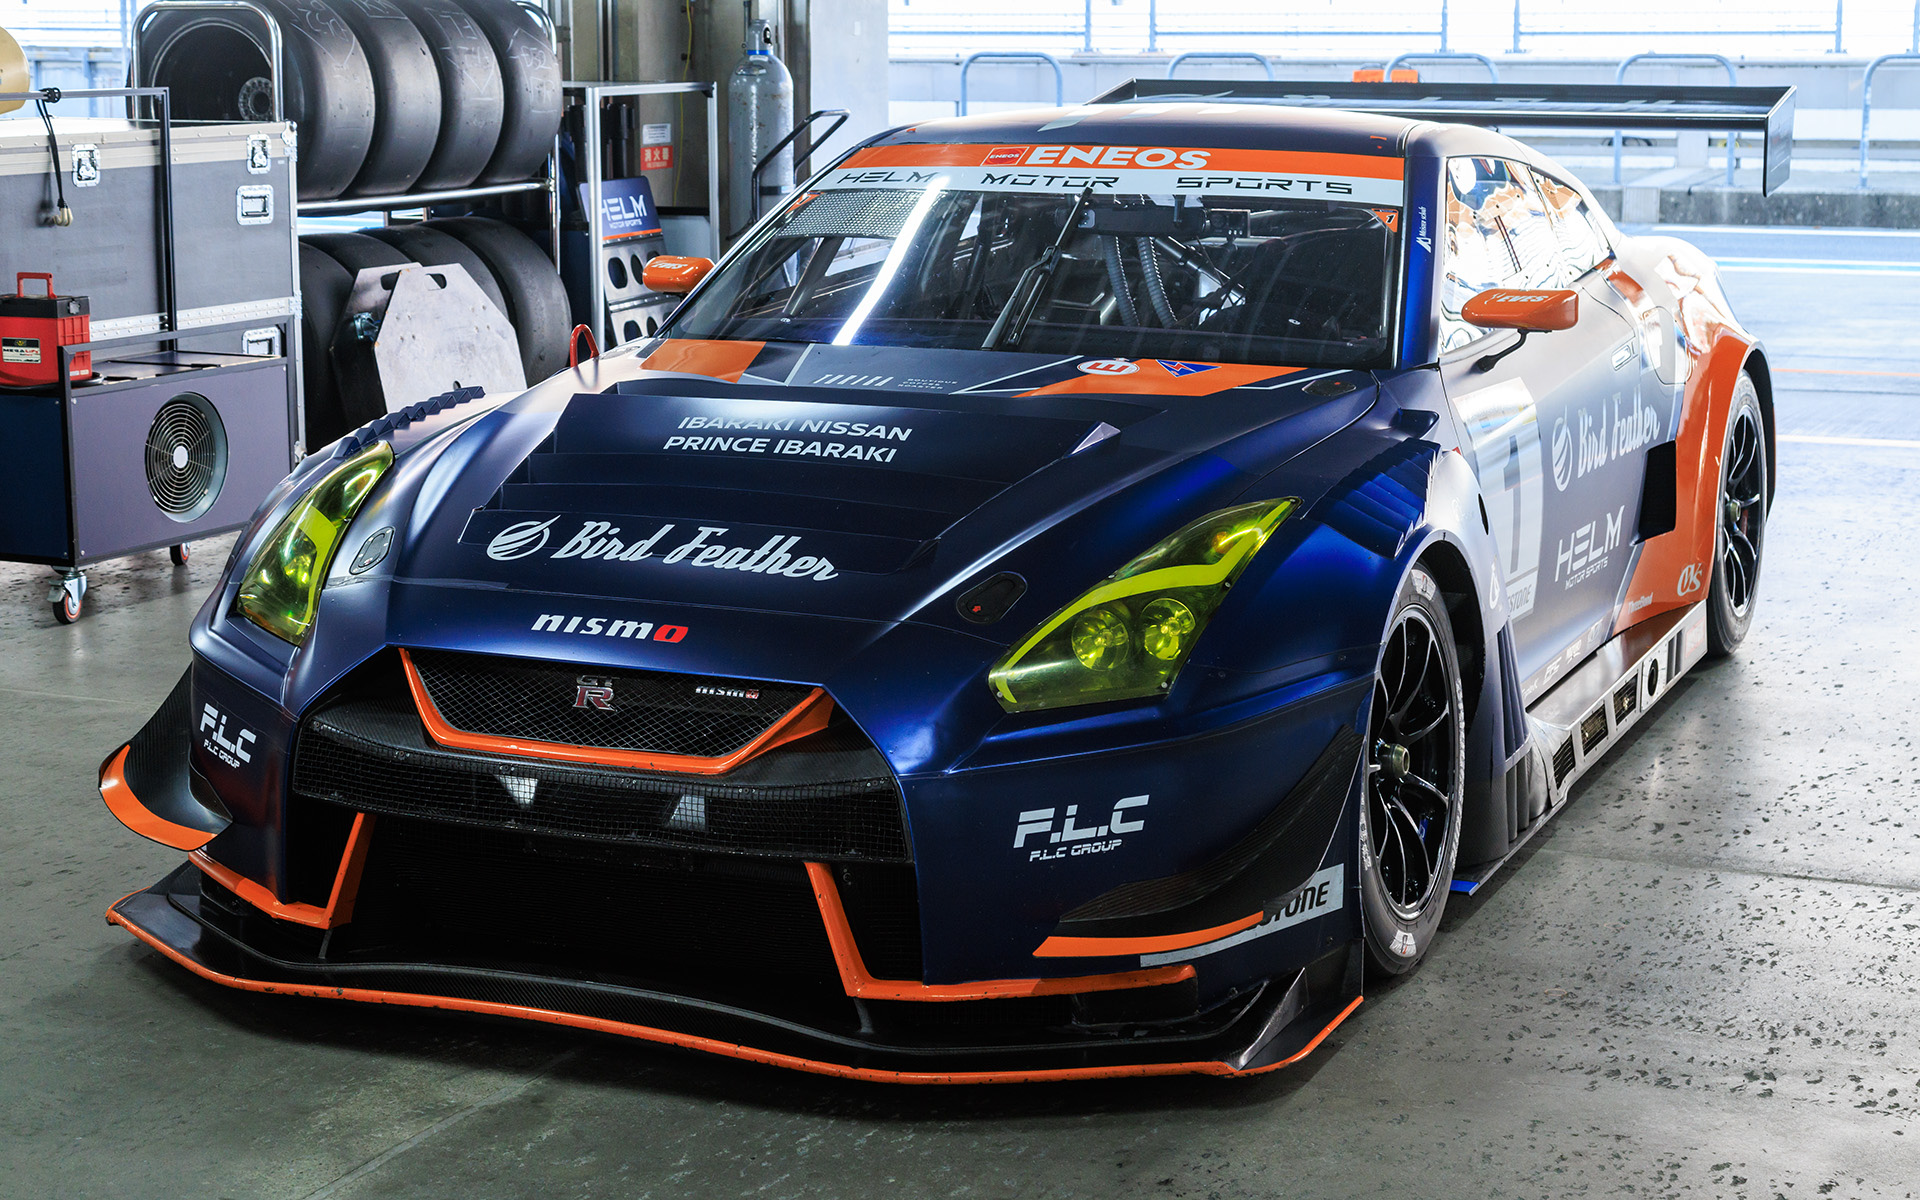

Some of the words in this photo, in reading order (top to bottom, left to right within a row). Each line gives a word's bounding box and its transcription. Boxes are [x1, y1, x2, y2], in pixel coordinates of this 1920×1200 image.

[1025, 146, 1211, 170] ENEOS
[837, 171, 939, 184] HELM
[980, 173, 1119, 188] MOTOR
[1176, 176, 1353, 195] SPORTS
[1386, 214, 1396, 224] 1
[677, 416, 797, 431] IBARAKI
[798, 419, 912, 441] NISSAN
[1578, 401, 1608, 478] Bird
[1611, 384, 1661, 461] Feather
[662, 436, 771, 453] PRINCE
[773, 439, 898, 463] IBARAKI
[550, 521, 675, 561] Bird
[662, 526, 839, 581] Feather
[1555, 505, 1625, 582] HELM
[530, 613, 689, 643] nismo
[576, 674, 620, 687] GT
[695, 685, 760, 699] nismo
[572, 685, 617, 712] R
[1013, 794, 1150, 849] F.L.C
[1029, 846, 1067, 862] F.L.C
[1070, 839, 1122, 856] GROUP
